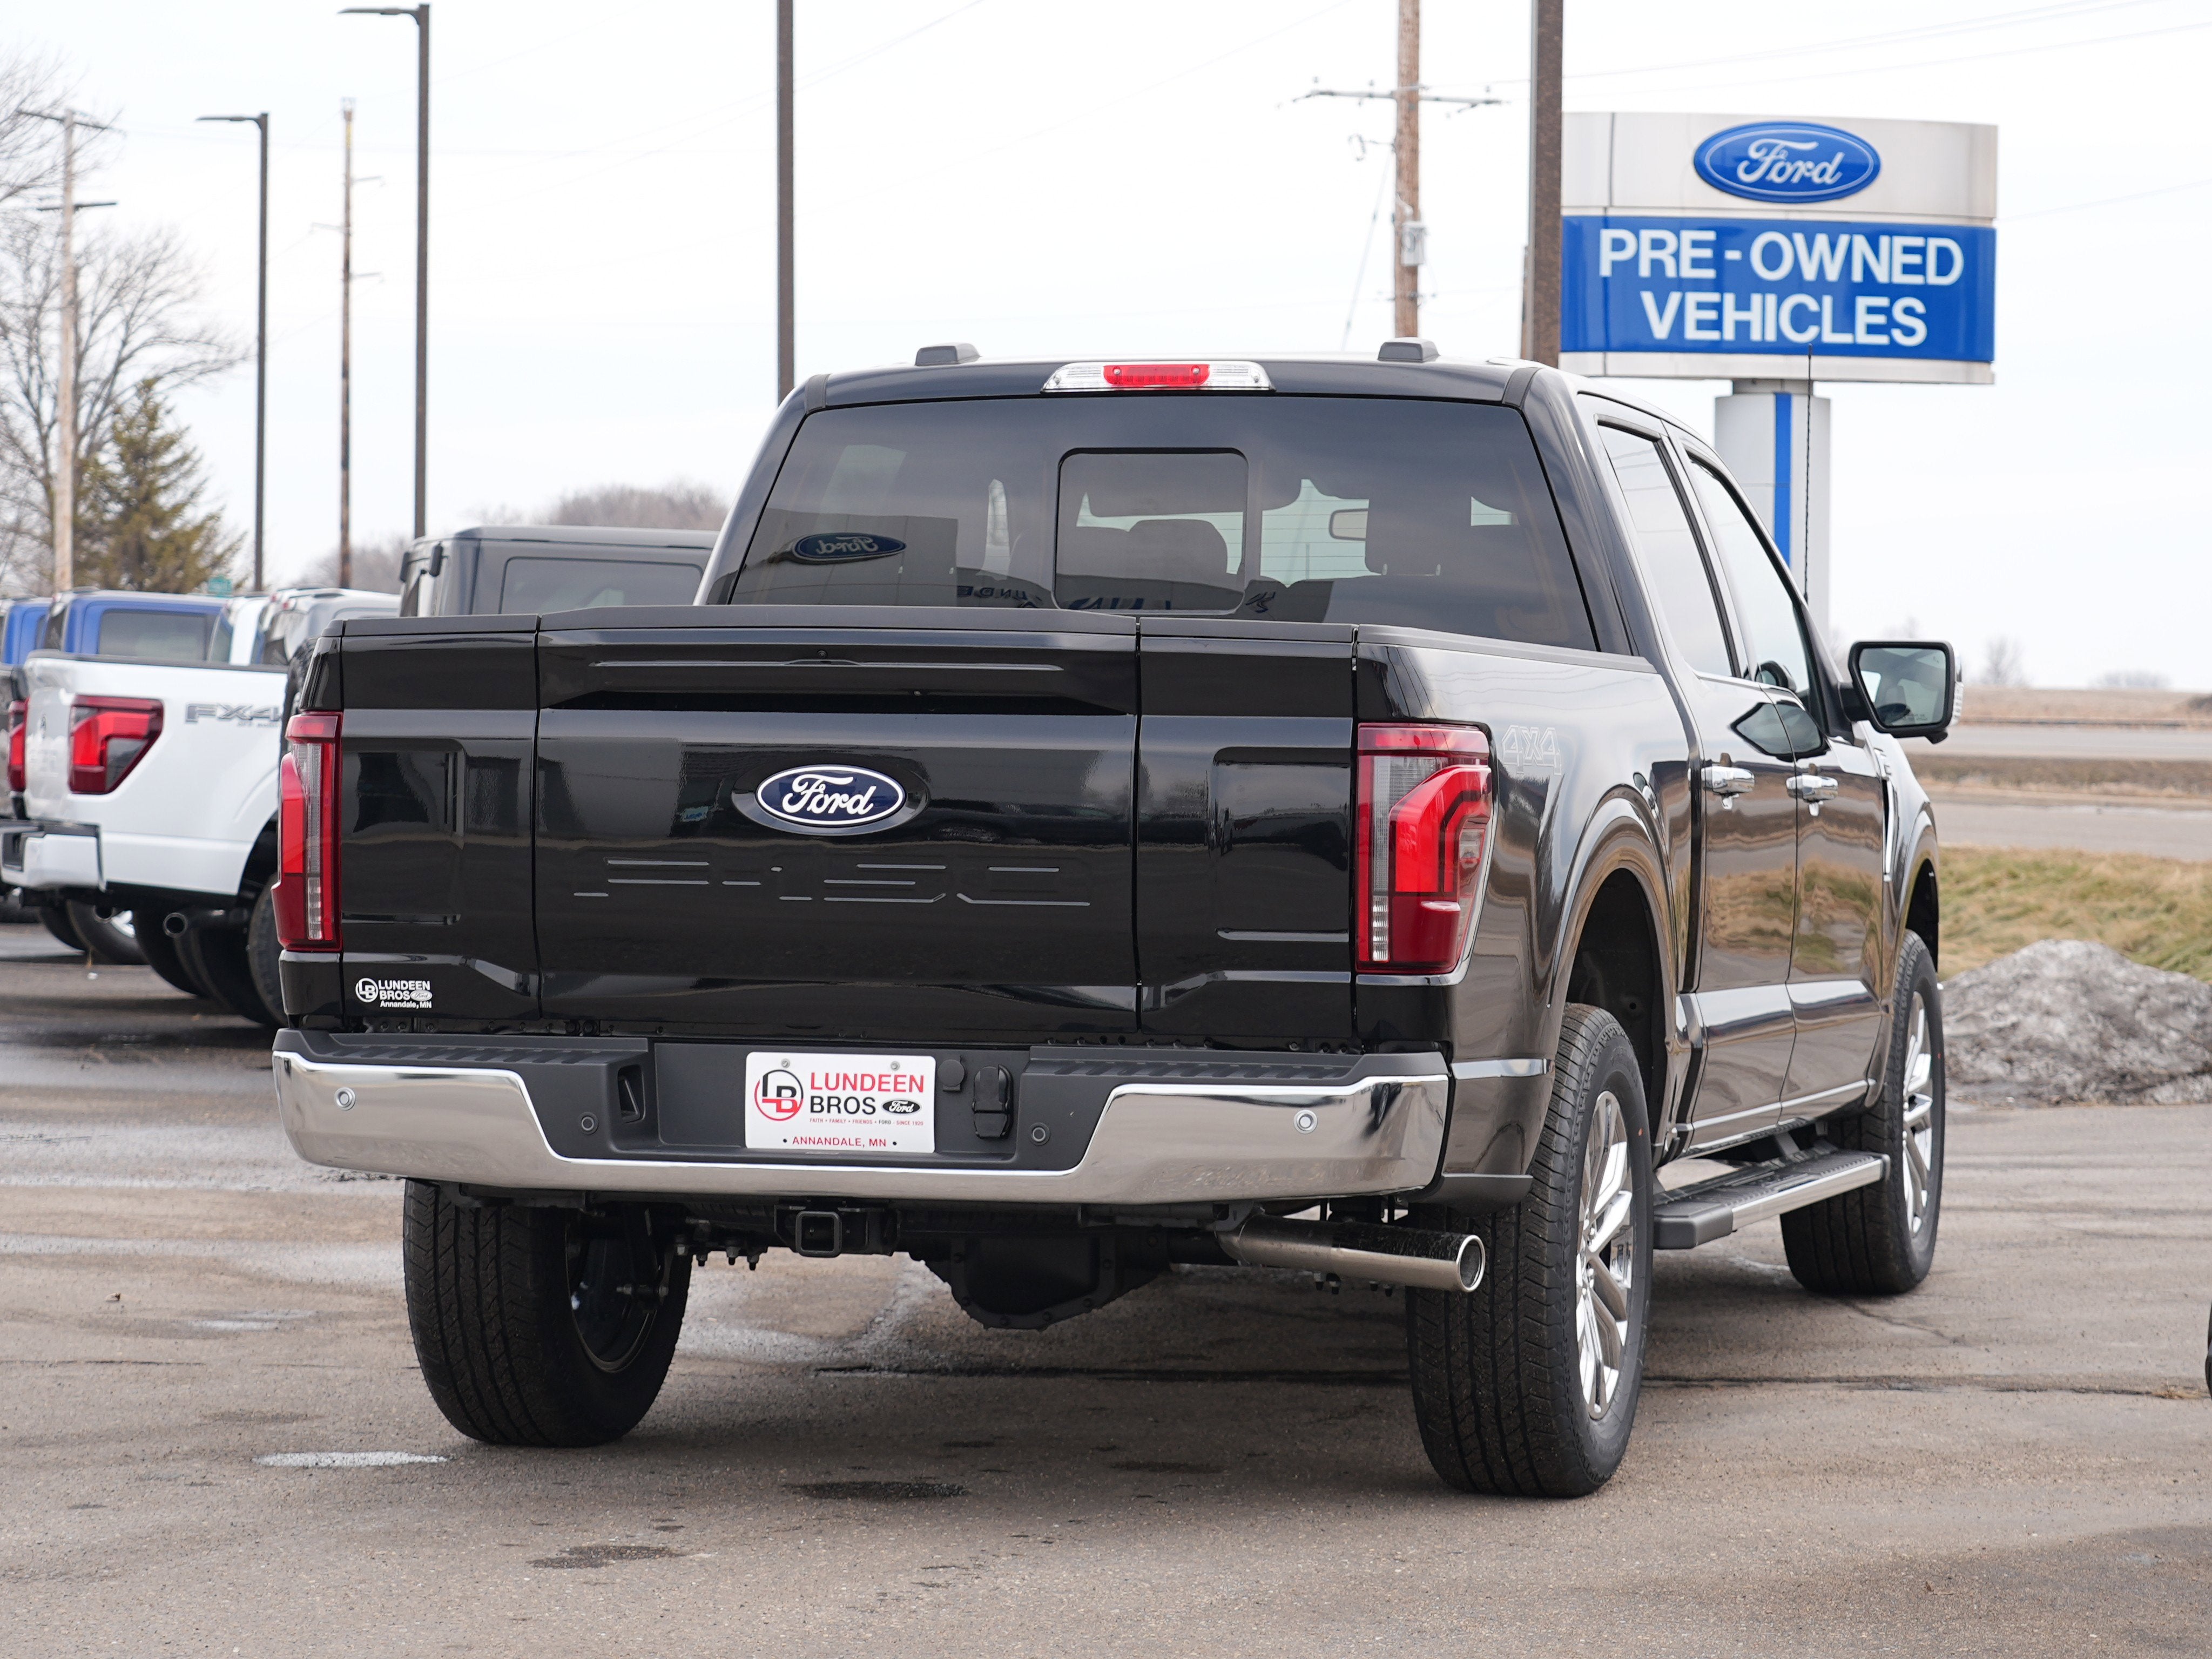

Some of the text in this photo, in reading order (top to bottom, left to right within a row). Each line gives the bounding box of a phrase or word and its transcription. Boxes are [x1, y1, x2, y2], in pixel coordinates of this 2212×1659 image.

[1736, 138, 1846, 185] Ford
[1599, 228, 1964, 286] PRE-OWNED
[1640, 291, 1927, 347] VEHICLES
[185, 703, 282, 722] FX4
[782, 774, 877, 815] Ford
[378, 980, 430, 990] LUNDEEN
[379, 990, 410, 1001] BROS
[380, 1000, 419, 1009] Annandale,
[811, 1072, 924, 1093] LUNDEEN
[810, 1095, 876, 1115] BROS
[792, 1136, 886, 1148] ANNANDALE, MN
